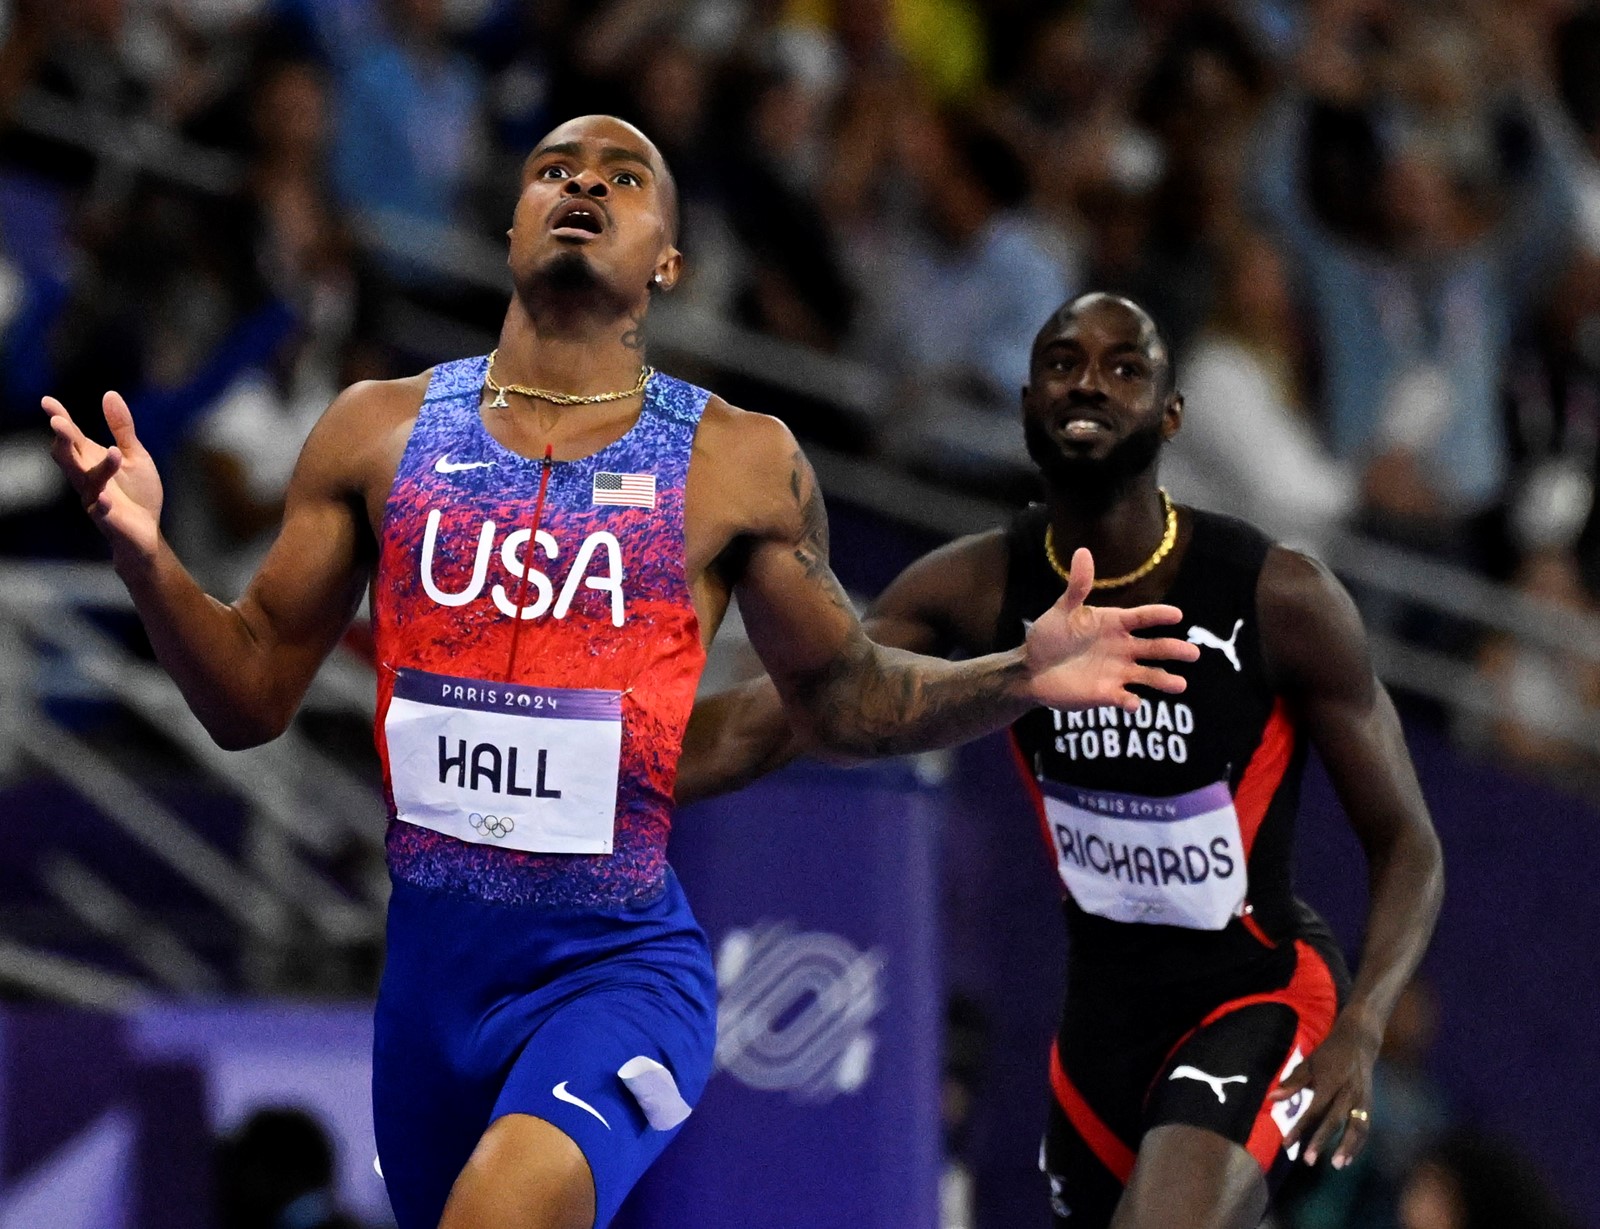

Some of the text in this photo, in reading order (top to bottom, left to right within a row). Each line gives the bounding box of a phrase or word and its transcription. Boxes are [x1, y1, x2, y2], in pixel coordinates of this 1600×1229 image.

[420, 508, 625, 627] USA
[442, 683, 558, 710] PARIS 2024
[437, 735, 562, 799] HALL
[1055, 823, 1234, 887] RICHARDS
